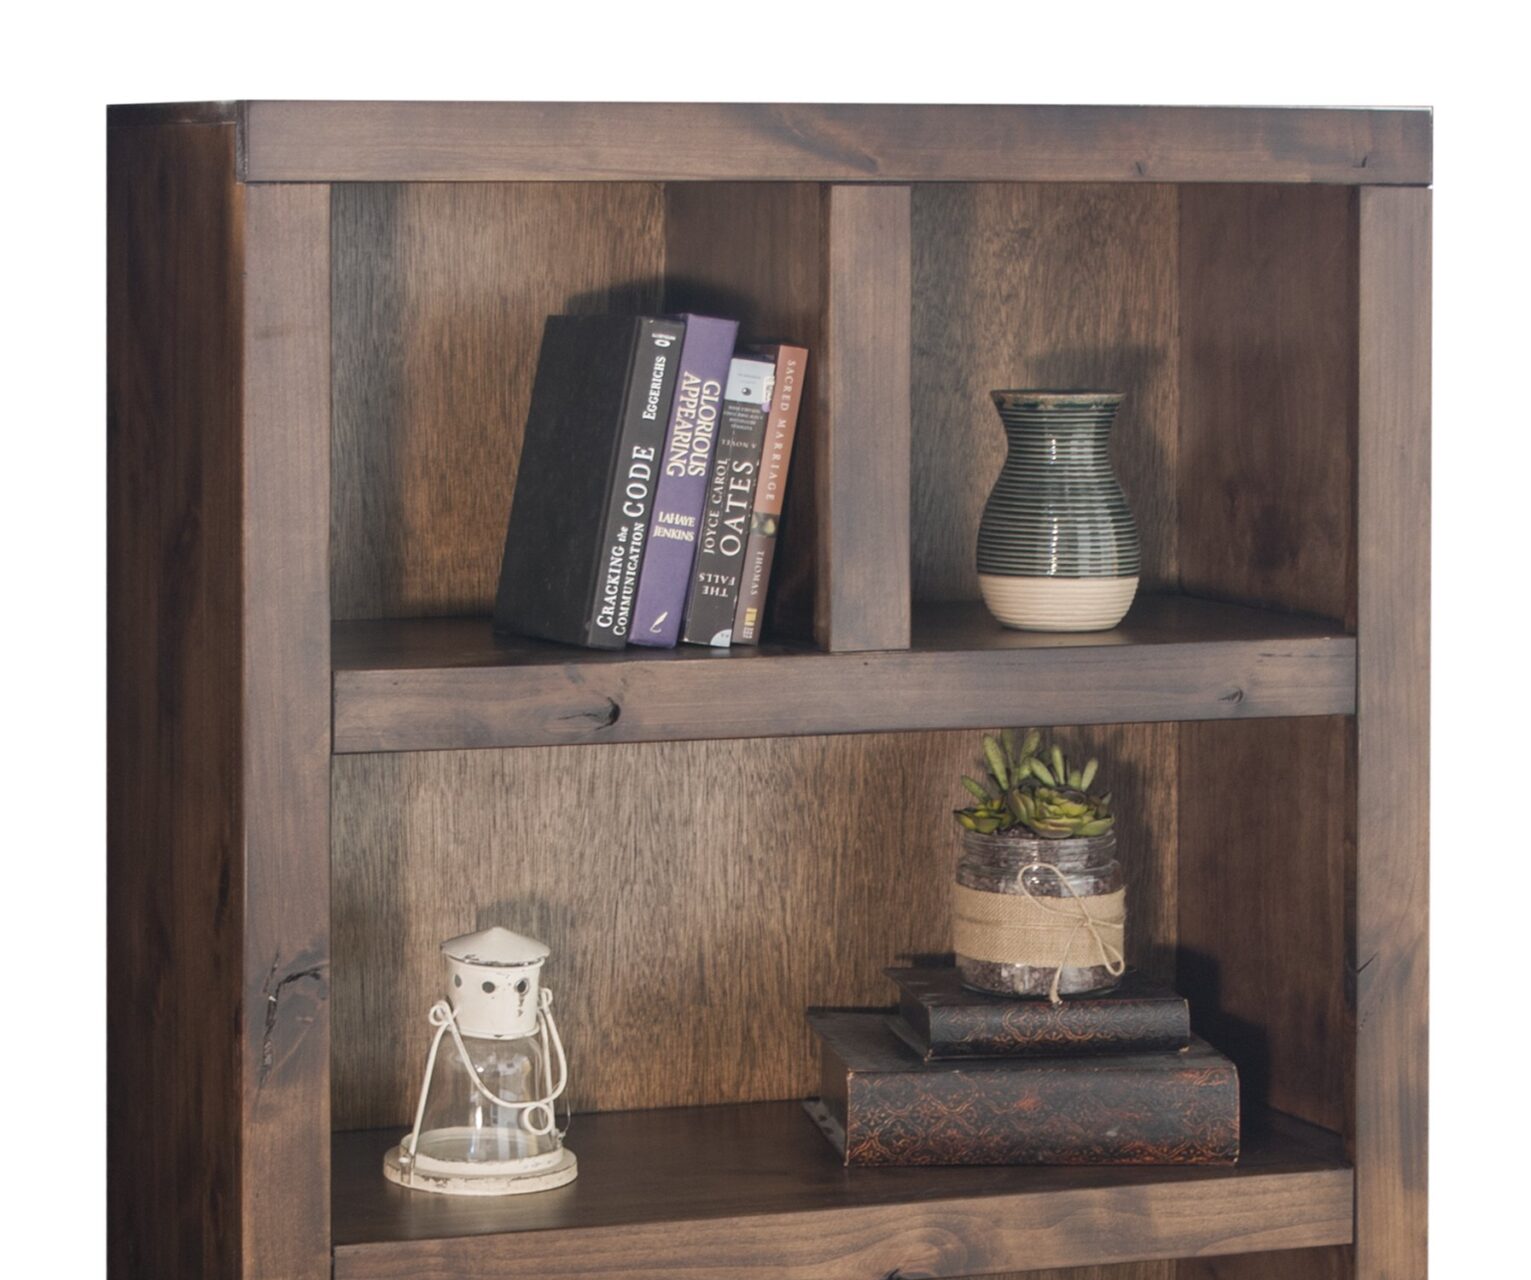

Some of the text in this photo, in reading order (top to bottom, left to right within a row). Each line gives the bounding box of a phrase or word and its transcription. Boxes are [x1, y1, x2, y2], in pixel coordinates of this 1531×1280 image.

[642, 356, 667, 420] EGGERICHS
[780, 359, 796, 412] SACRED
[666, 371, 702, 478] APPEARING
[687, 380, 721, 477] GLORIOUS
[766, 418, 787, 501] MARRIAGE
[623, 446, 655, 518] CODE
[703, 458, 730, 554] JOYCE CAROL
[720, 460, 753, 556] OATES
[652, 525, 695, 543] JENKINS
[596, 526, 628, 628] CRACKING the
[613, 522, 645, 636] COMMUNICATION
[699, 572, 736, 586] FALLS
[702, 585, 729, 598] THE
[751, 551, 765, 595] THOMAS
